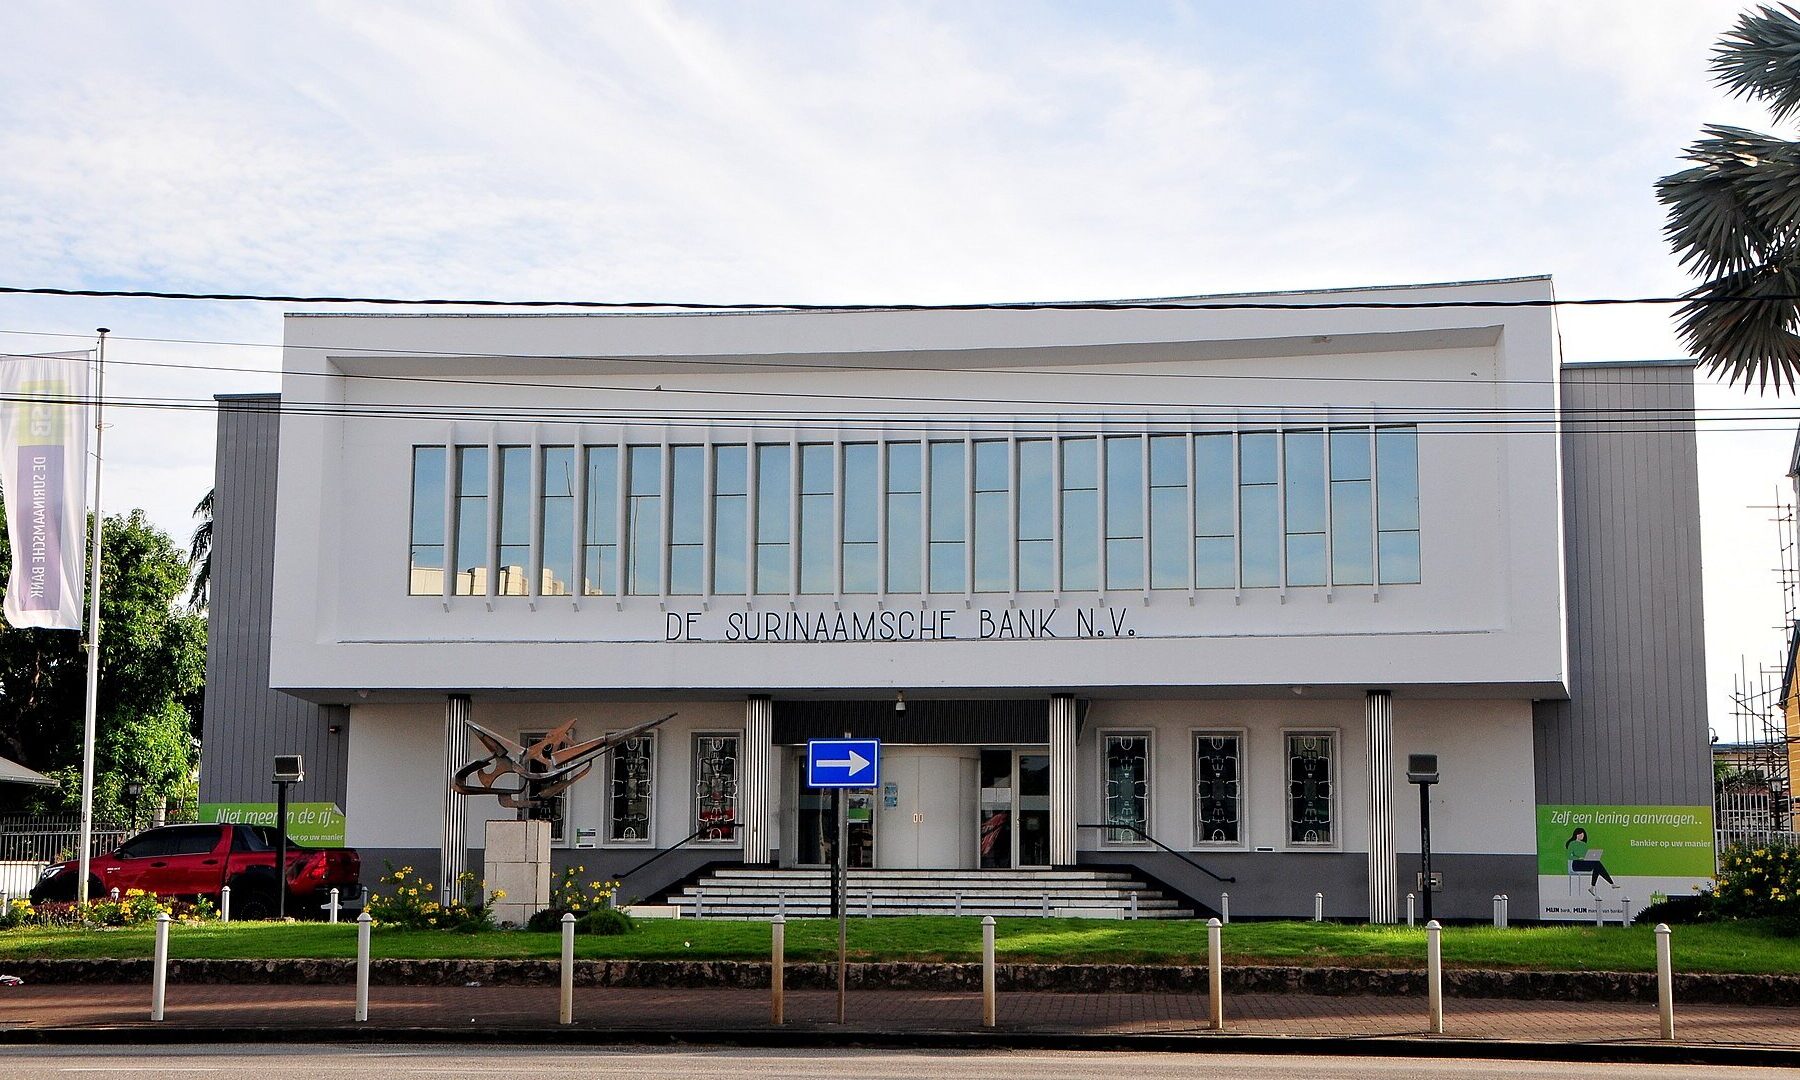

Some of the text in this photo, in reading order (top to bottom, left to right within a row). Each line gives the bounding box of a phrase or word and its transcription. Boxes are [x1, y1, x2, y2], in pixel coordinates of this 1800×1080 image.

[665, 607, 1136, 641] DE SURINAAMSCHE BANK N.V.
[215, 808, 241, 824] Niet
[244, 812, 278, 825] meer
[297, 808, 313, 824] de
[318, 808, 340, 828] rij..
[1551, 811, 1703, 828] Zelf een lening aanvragen..
[299, 834, 309, 842] op
[320, 833, 344, 841] manier
[1630, 839, 1659, 847] Bankier
[1659, 840, 1670, 849] op
[1684, 839, 1711, 847] manier
